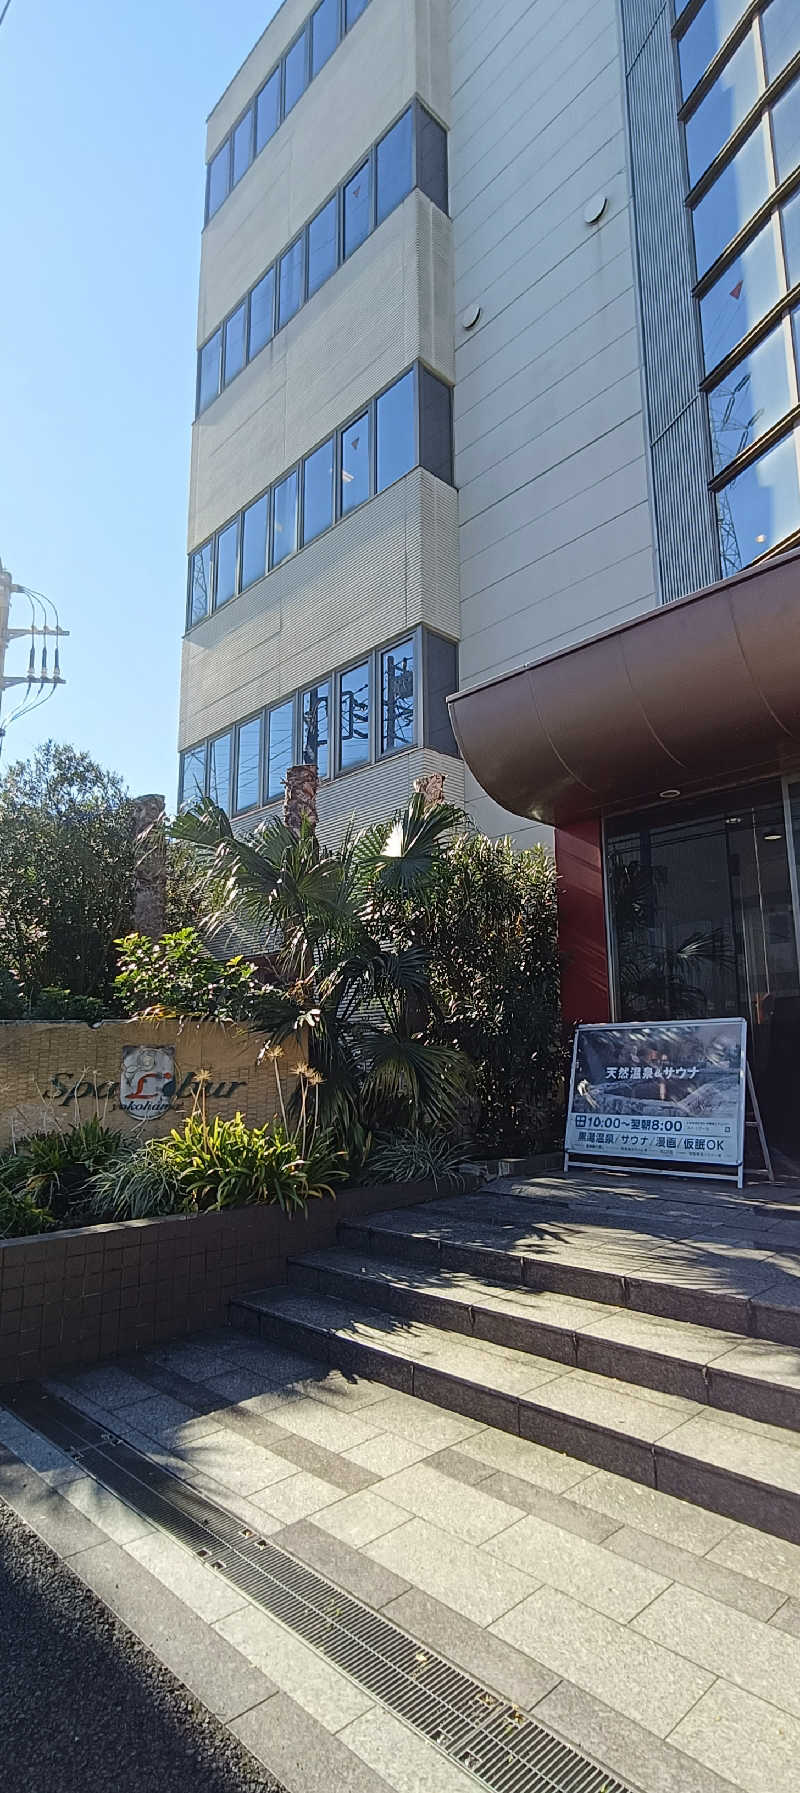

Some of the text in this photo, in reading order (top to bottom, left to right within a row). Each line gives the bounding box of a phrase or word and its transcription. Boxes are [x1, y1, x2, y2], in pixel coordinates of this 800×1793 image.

[605, 1067, 700, 1080] 天然温泉&サウナ
[43, 1072, 120, 1107] Spa
